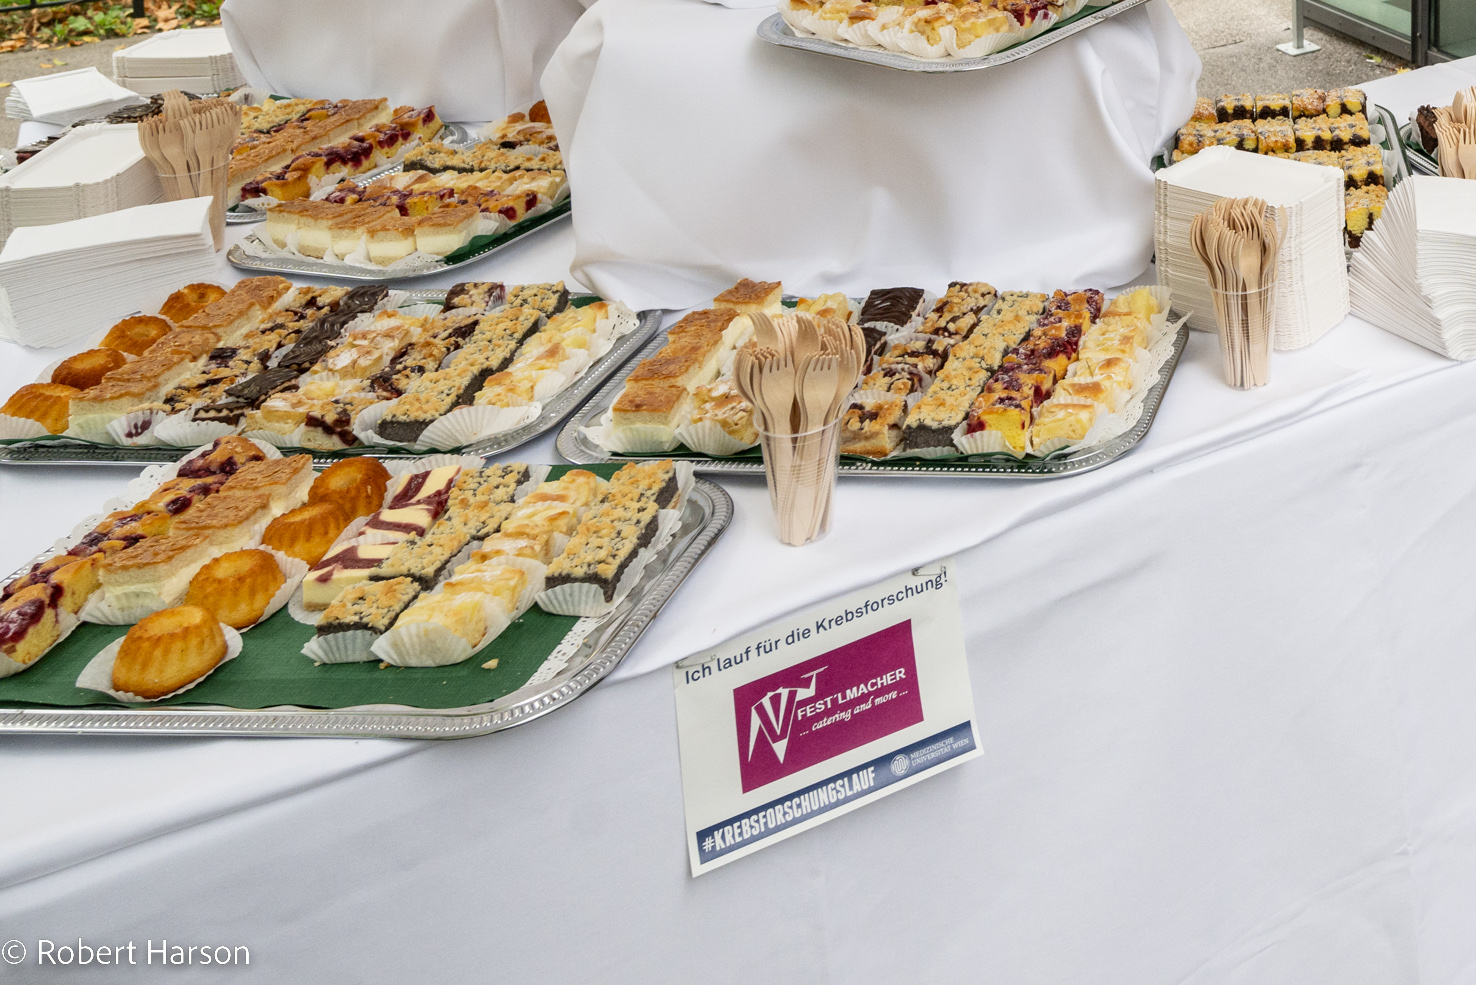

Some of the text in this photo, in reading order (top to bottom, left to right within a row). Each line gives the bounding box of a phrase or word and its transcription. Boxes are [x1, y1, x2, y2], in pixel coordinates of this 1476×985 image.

[685, 570, 949, 685] Ich lauf für die Krebsforschung!
[811, 708, 852, 732] catering
[853, 700, 873, 716] and
[874, 691, 898, 707] more
[910, 736, 955, 760] MEDIZINISCHE
[952, 738, 970, 751] WIEN
[702, 766, 876, 853] #KREBSFORSCHUNGSLAUF
